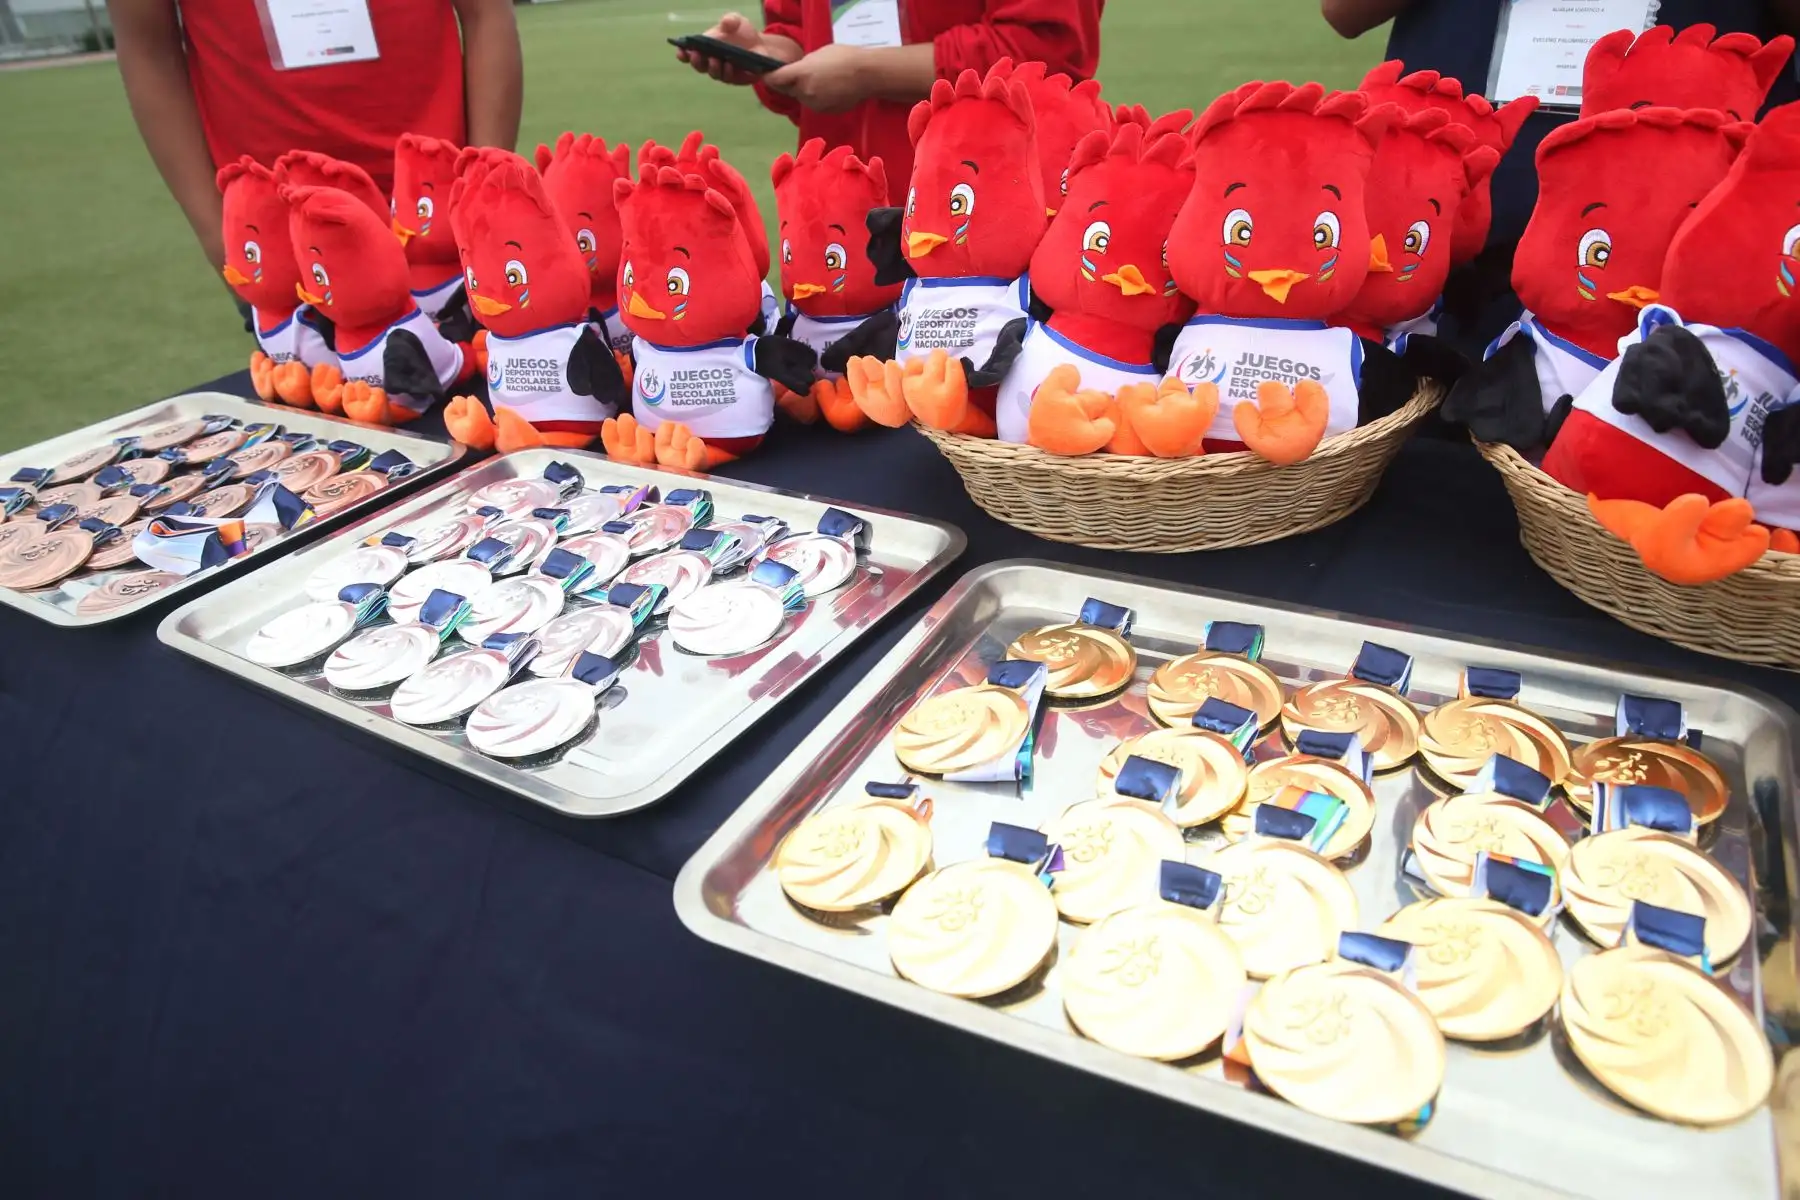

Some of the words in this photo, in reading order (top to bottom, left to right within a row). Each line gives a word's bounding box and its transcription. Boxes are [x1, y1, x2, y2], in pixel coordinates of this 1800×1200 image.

[918, 307, 979, 319] JUEGOS
[915, 320, 976, 329] DEPORTIVOS
[915, 329, 974, 339] ESCOLARES
[915, 339, 974, 348] NACIONALES
[505, 358, 559, 369] JUEGOS
[1235, 352, 1321, 380] JUEGOS
[505, 369, 559, 377] DEPORTIVOS
[670, 368, 733, 381] JUEGOS
[505, 377, 560, 385] ESCOLARES
[670, 380, 734, 390] DEPORTIVOS
[670, 388, 735, 398] ESCOLARES
[671, 397, 737, 406] NACIONALES
